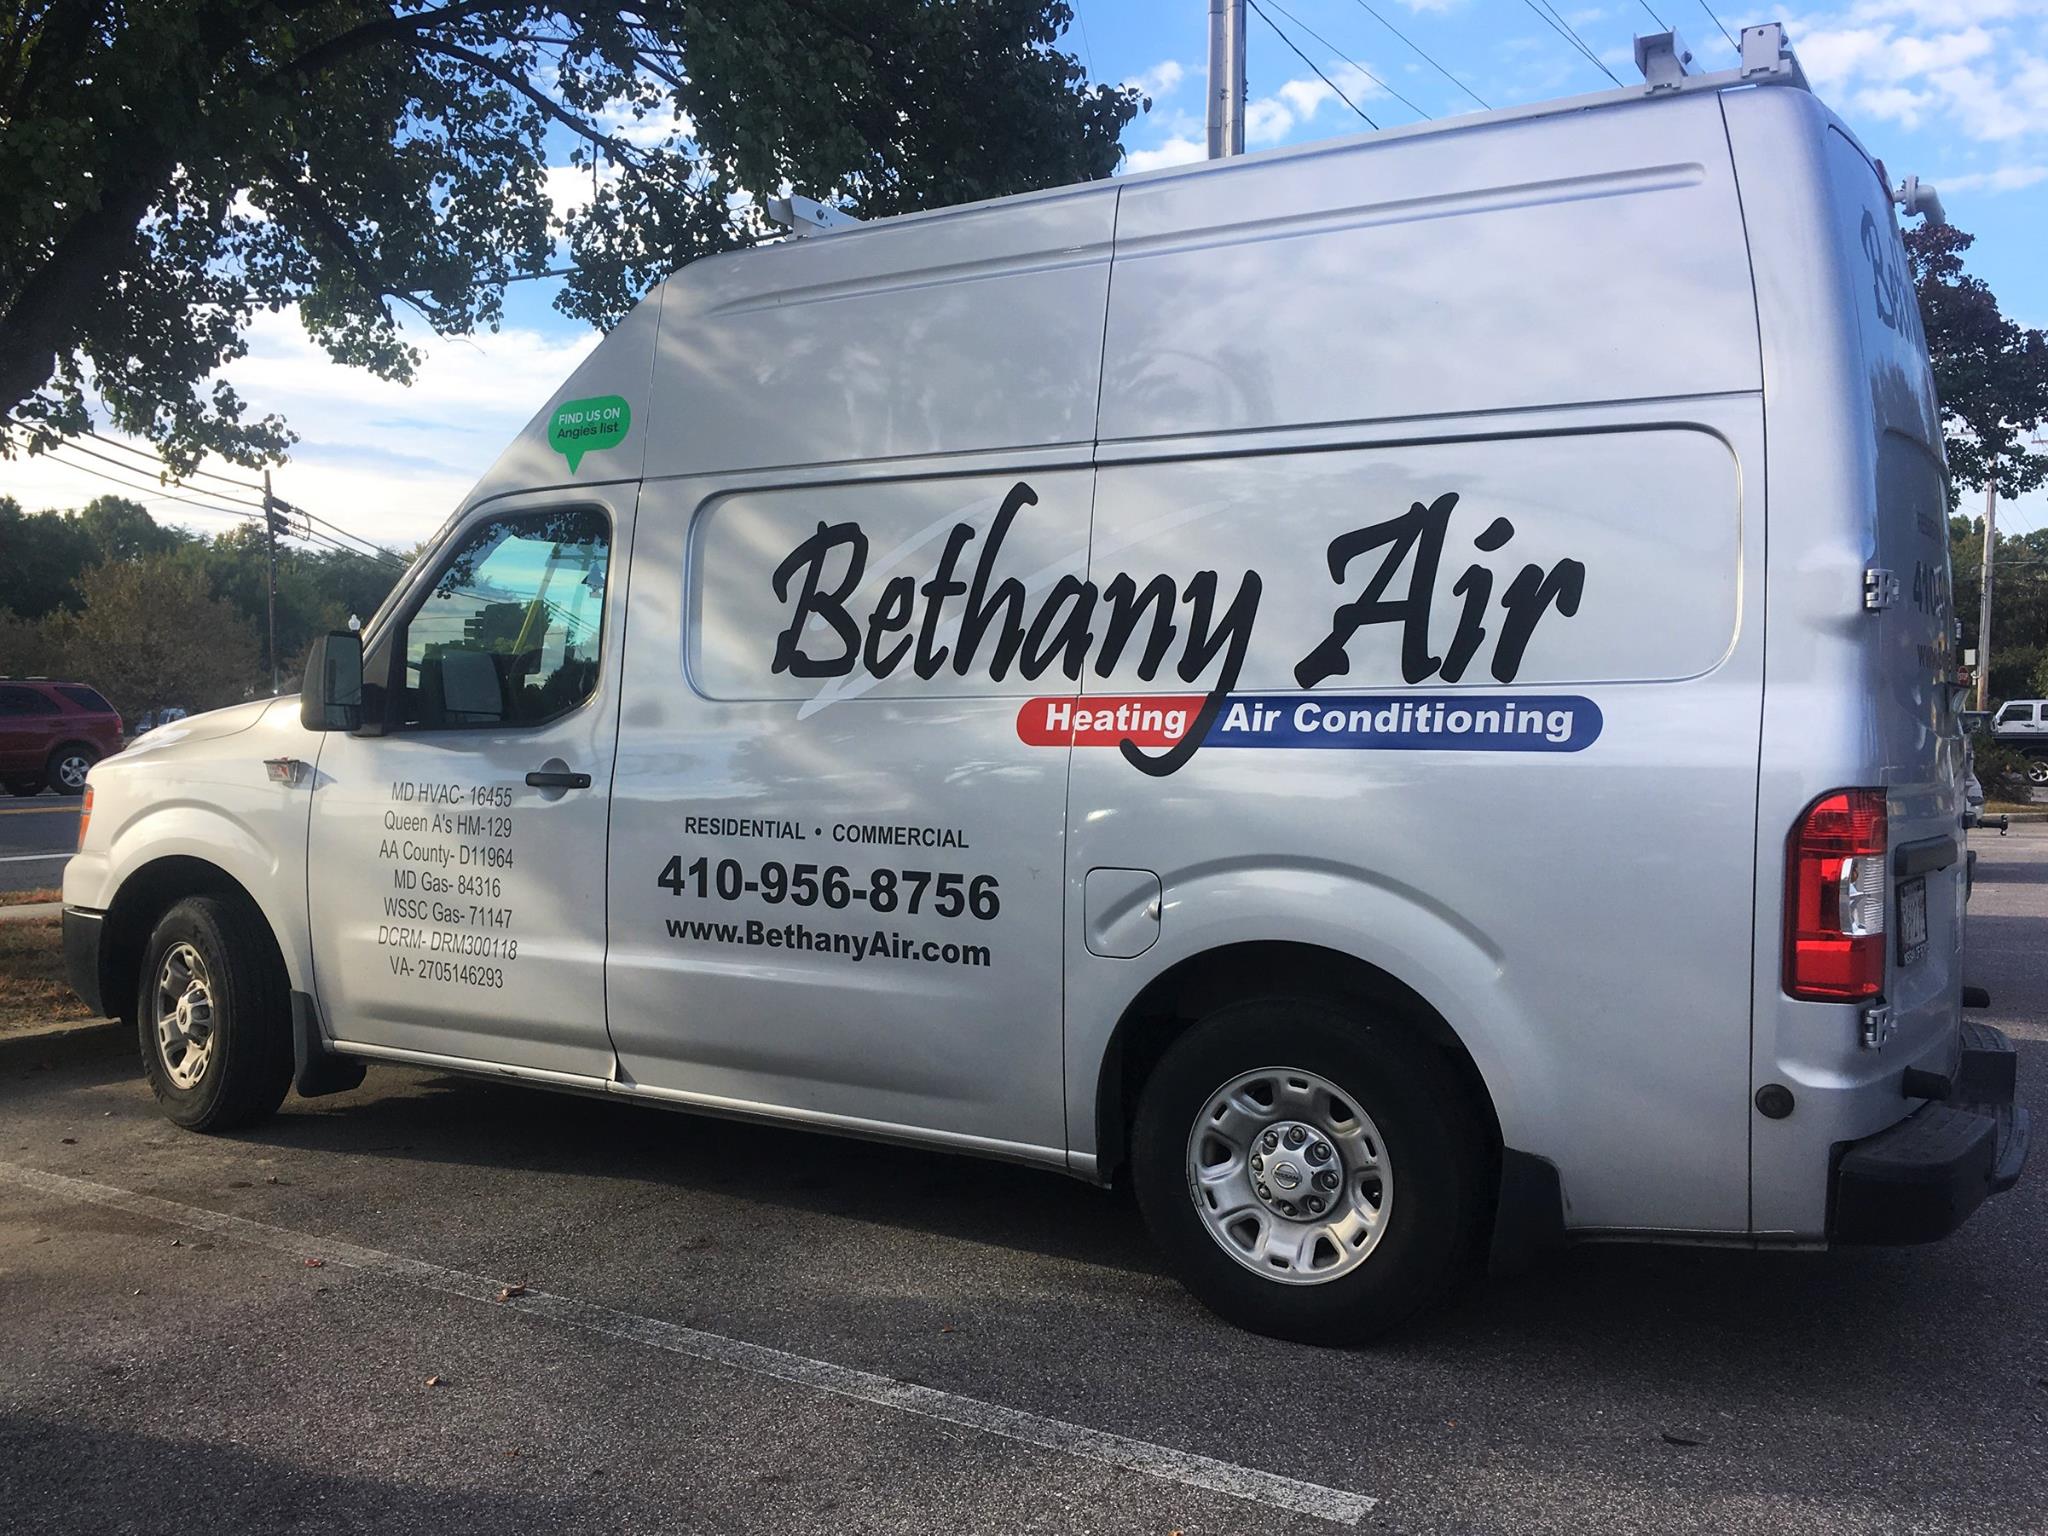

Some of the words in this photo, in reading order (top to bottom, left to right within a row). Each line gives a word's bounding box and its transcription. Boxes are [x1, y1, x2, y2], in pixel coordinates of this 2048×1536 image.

[558, 412, 583, 424] FIND
[586, 409, 600, 421] US
[603, 407, 620, 419] ON
[600, 422, 618, 433] list
[772, 481, 1263, 778] Bethany
[1294, 492, 1586, 690] Air
[1045, 703, 1187, 739] Heating
[1222, 703, 1281, 732] Air
[1293, 702, 1575, 743] Conditioning
[391, 782, 415, 801] MD
[418, 784, 465, 805] HVAC-
[470, 787, 512, 808] 16455
[384, 811, 428, 832] Queen
[432, 813, 453, 834] A's
[457, 814, 512, 838] HM-129
[685, 817, 806, 840] RESIDENTIAL
[832, 823, 970, 848] COMMERCIAL
[379, 839, 399, 859] AA
[403, 841, 455, 868] County-
[459, 845, 514, 869] D11964
[394, 869, 417, 890] MD
[421, 872, 454, 893] Gas-
[458, 875, 501, 898] 84316
[657, 855, 1001, 920] 410-956-8756
[384, 897, 428, 920] WSSC
[432, 902, 465, 924] Gas-
[469, 906, 513, 929] 71147
[378, 925, 427, 949] DCRM-
[430, 931, 518, 960] DRM300118
[665, 919, 992, 967] www.BethanyAir.com
[390, 956, 415, 977] VA-
[418, 959, 504, 988] 2705146293
